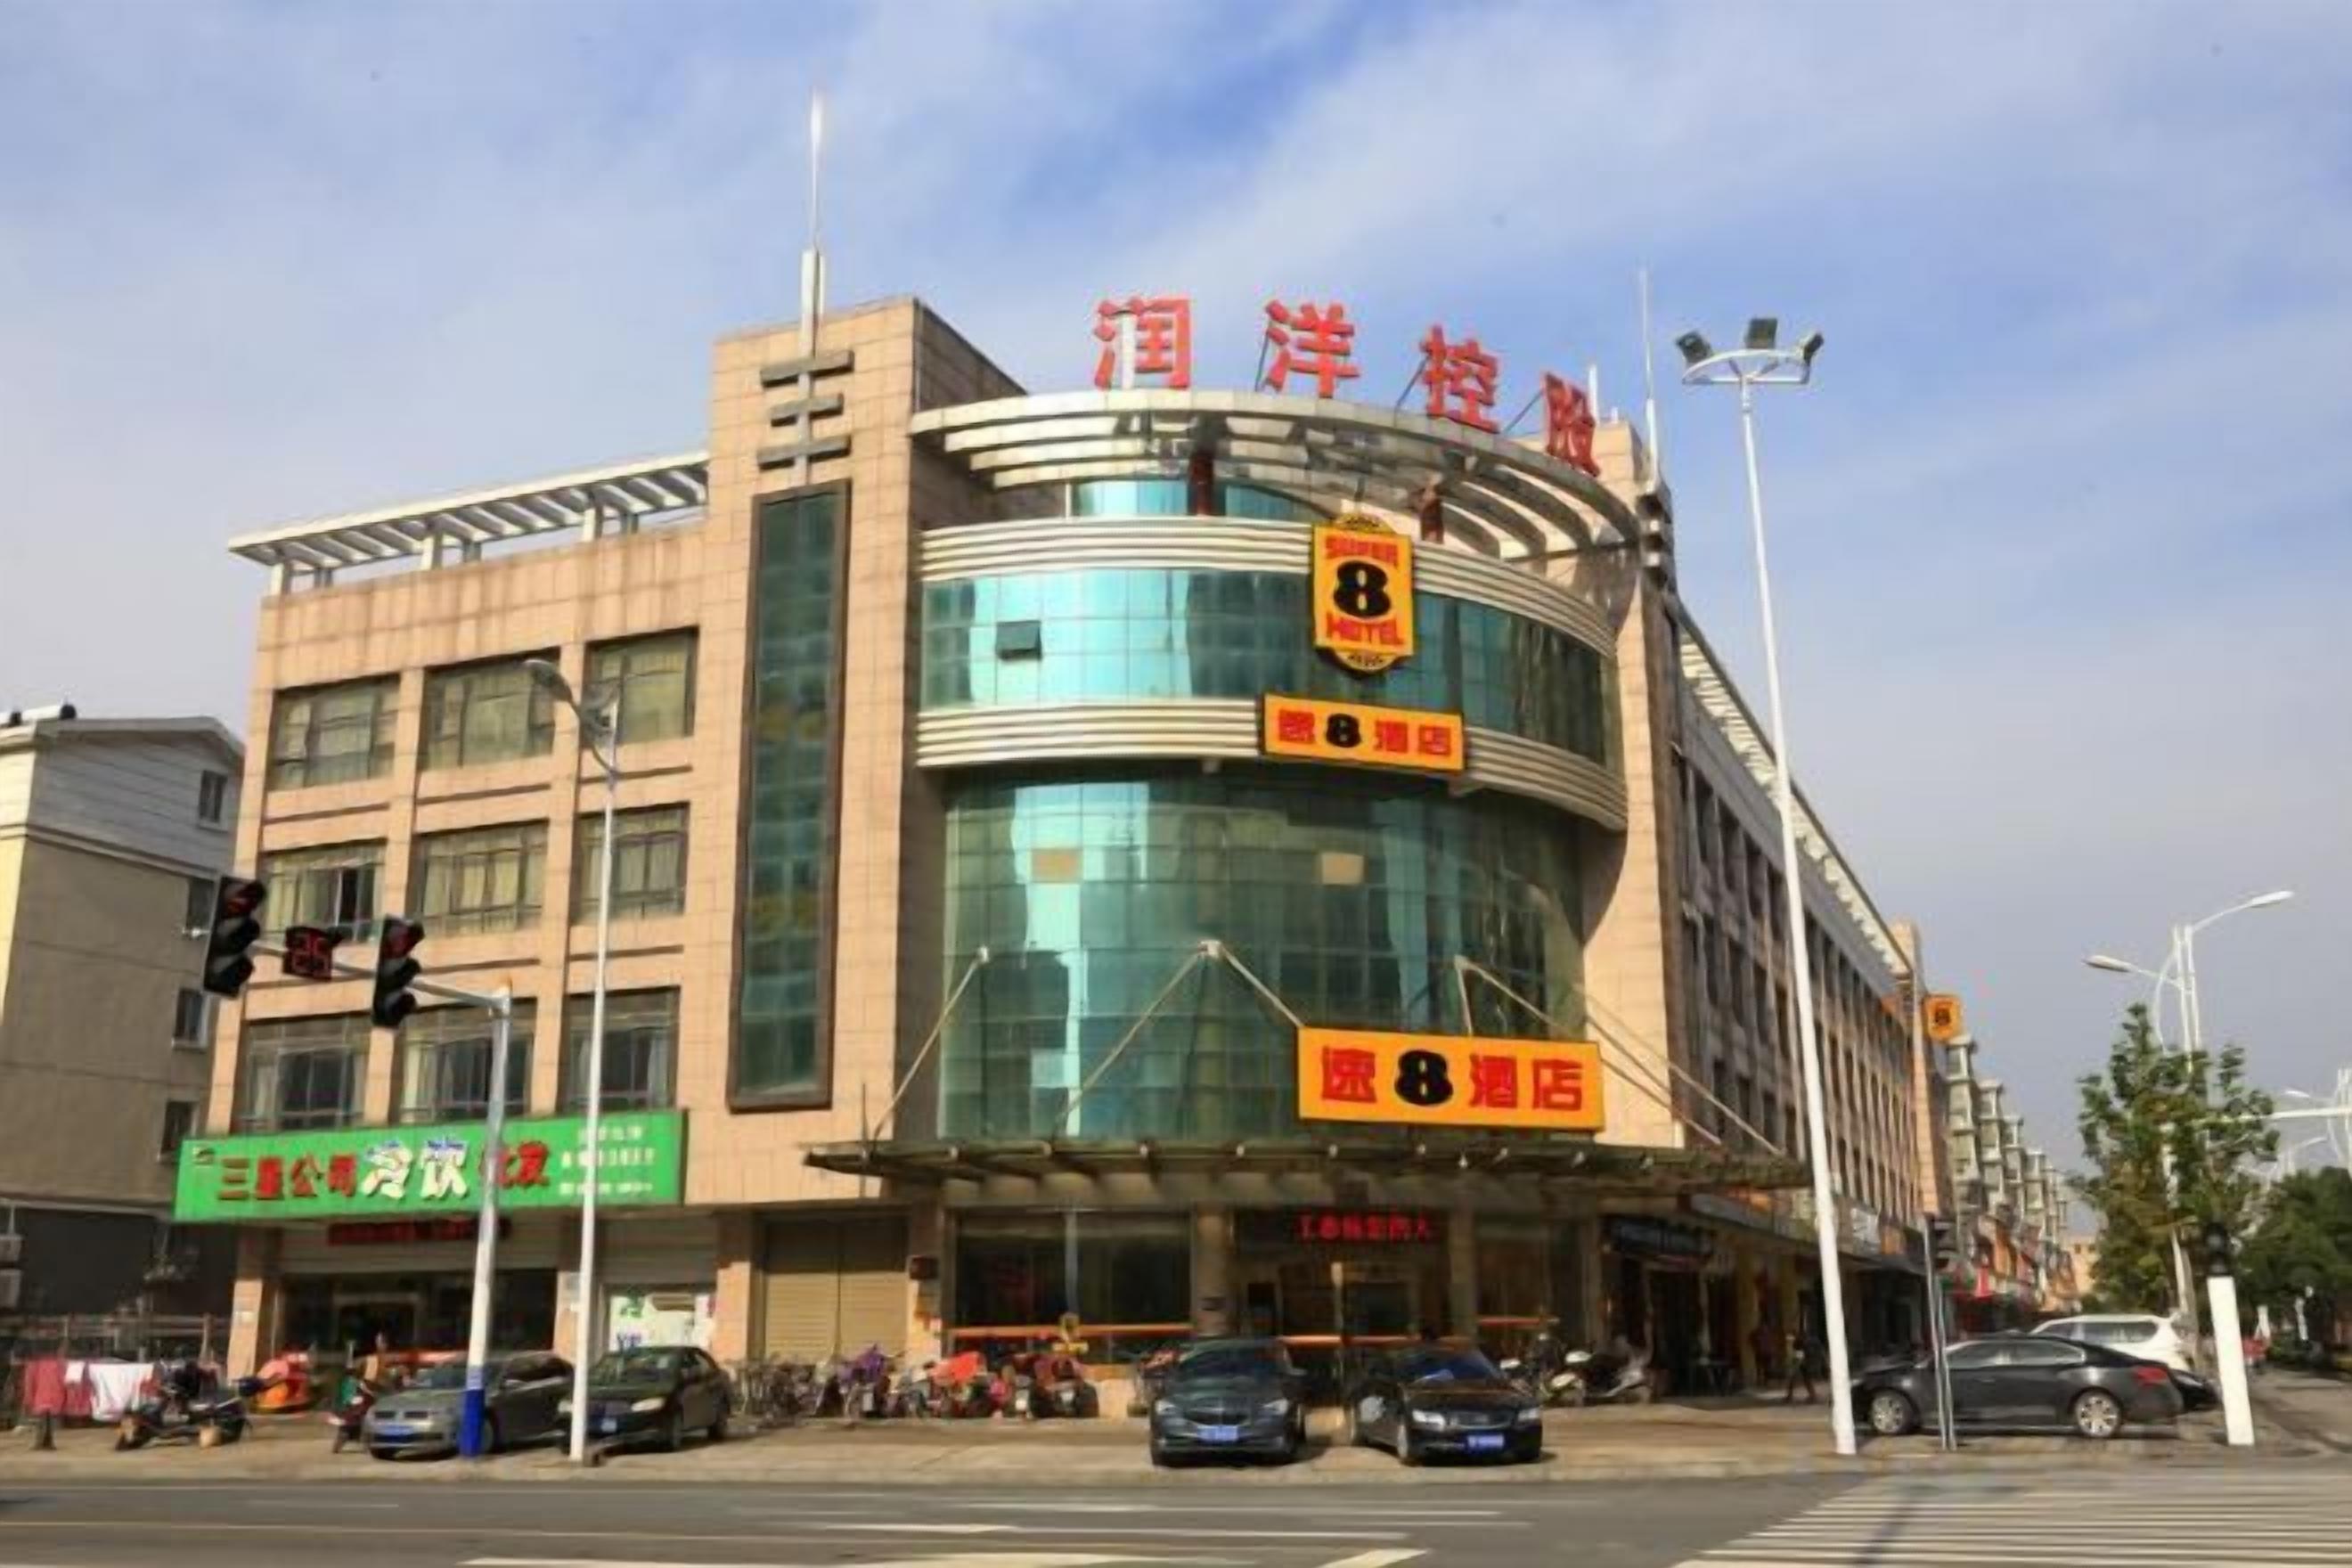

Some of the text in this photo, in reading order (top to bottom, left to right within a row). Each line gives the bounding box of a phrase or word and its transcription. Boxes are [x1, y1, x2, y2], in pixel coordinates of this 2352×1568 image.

[1093, 297, 1601, 477] 润洋控股
[1333, 559, 1392, 618] 8
[1321, 1045, 1585, 1112] 速8酒店
